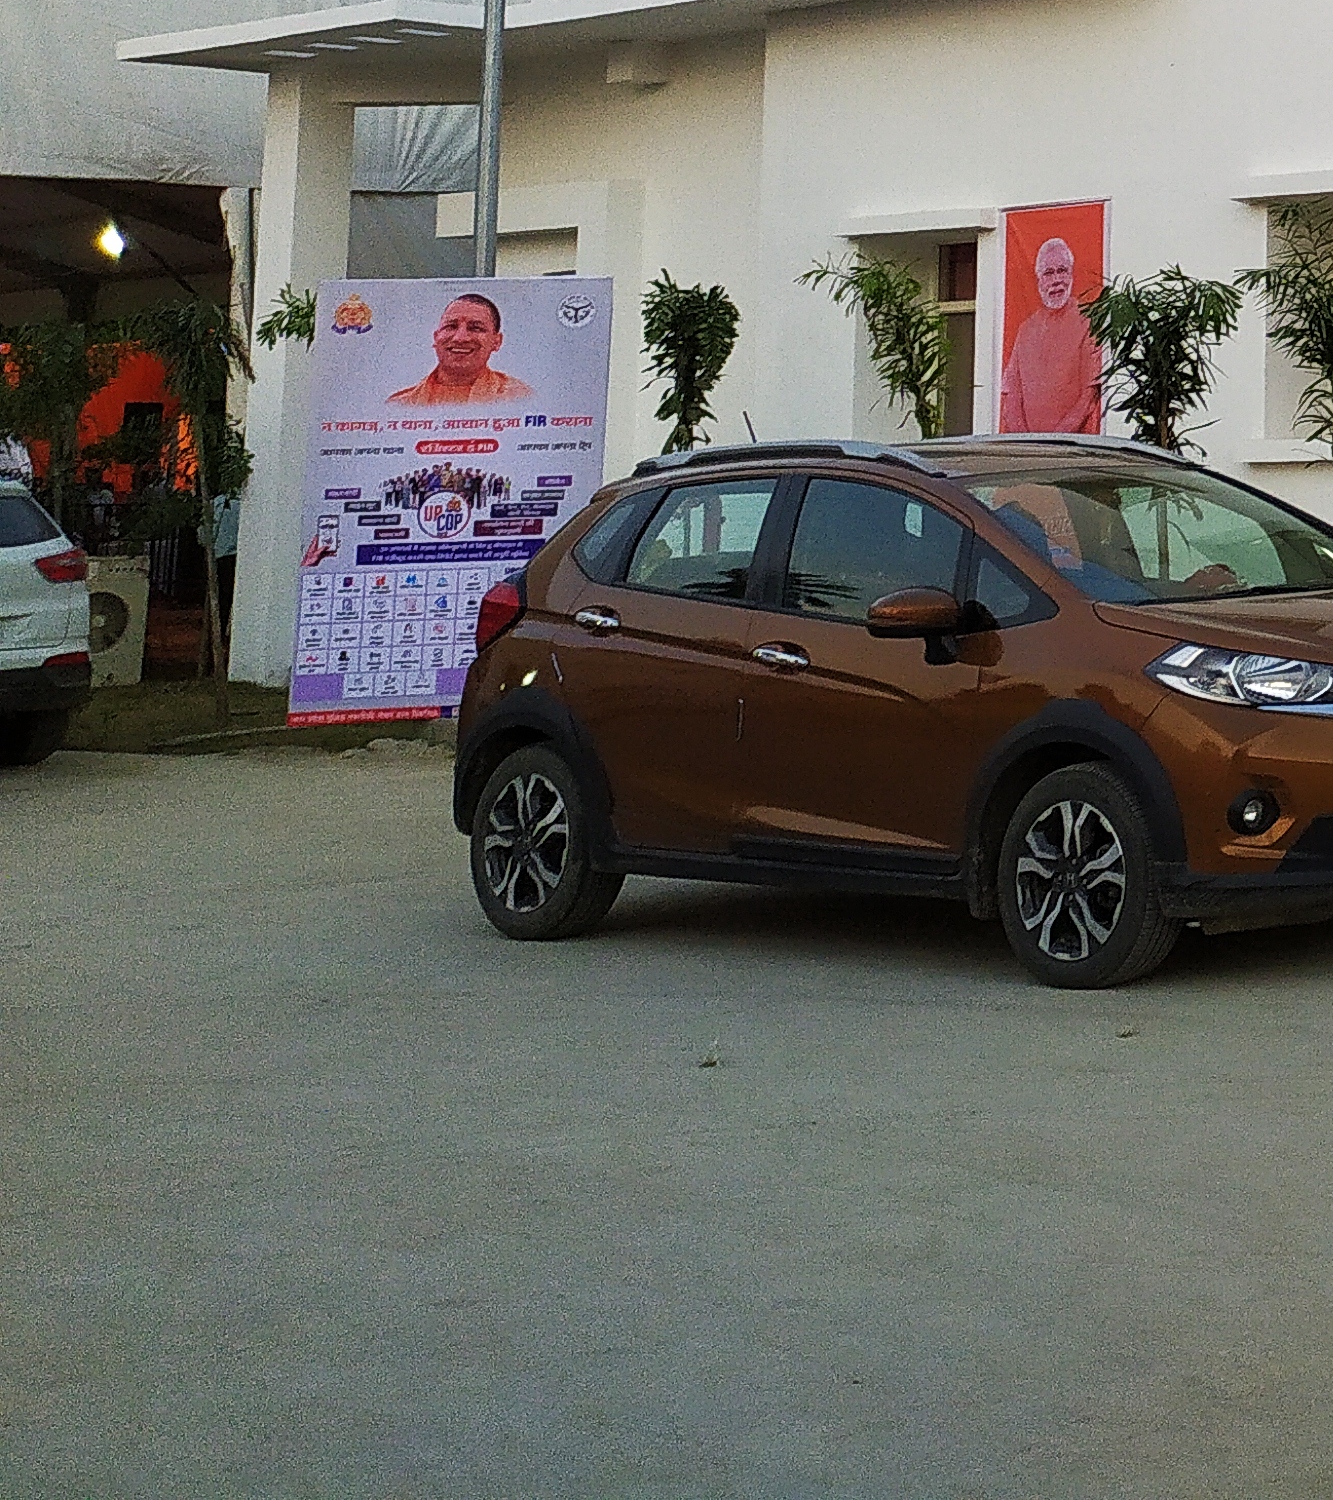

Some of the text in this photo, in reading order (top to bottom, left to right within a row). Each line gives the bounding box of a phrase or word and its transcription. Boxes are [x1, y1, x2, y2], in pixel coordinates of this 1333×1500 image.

[524, 415, 548, 427] FIR
[424, 505, 443, 521] UP
[436, 513, 463, 532] COP
